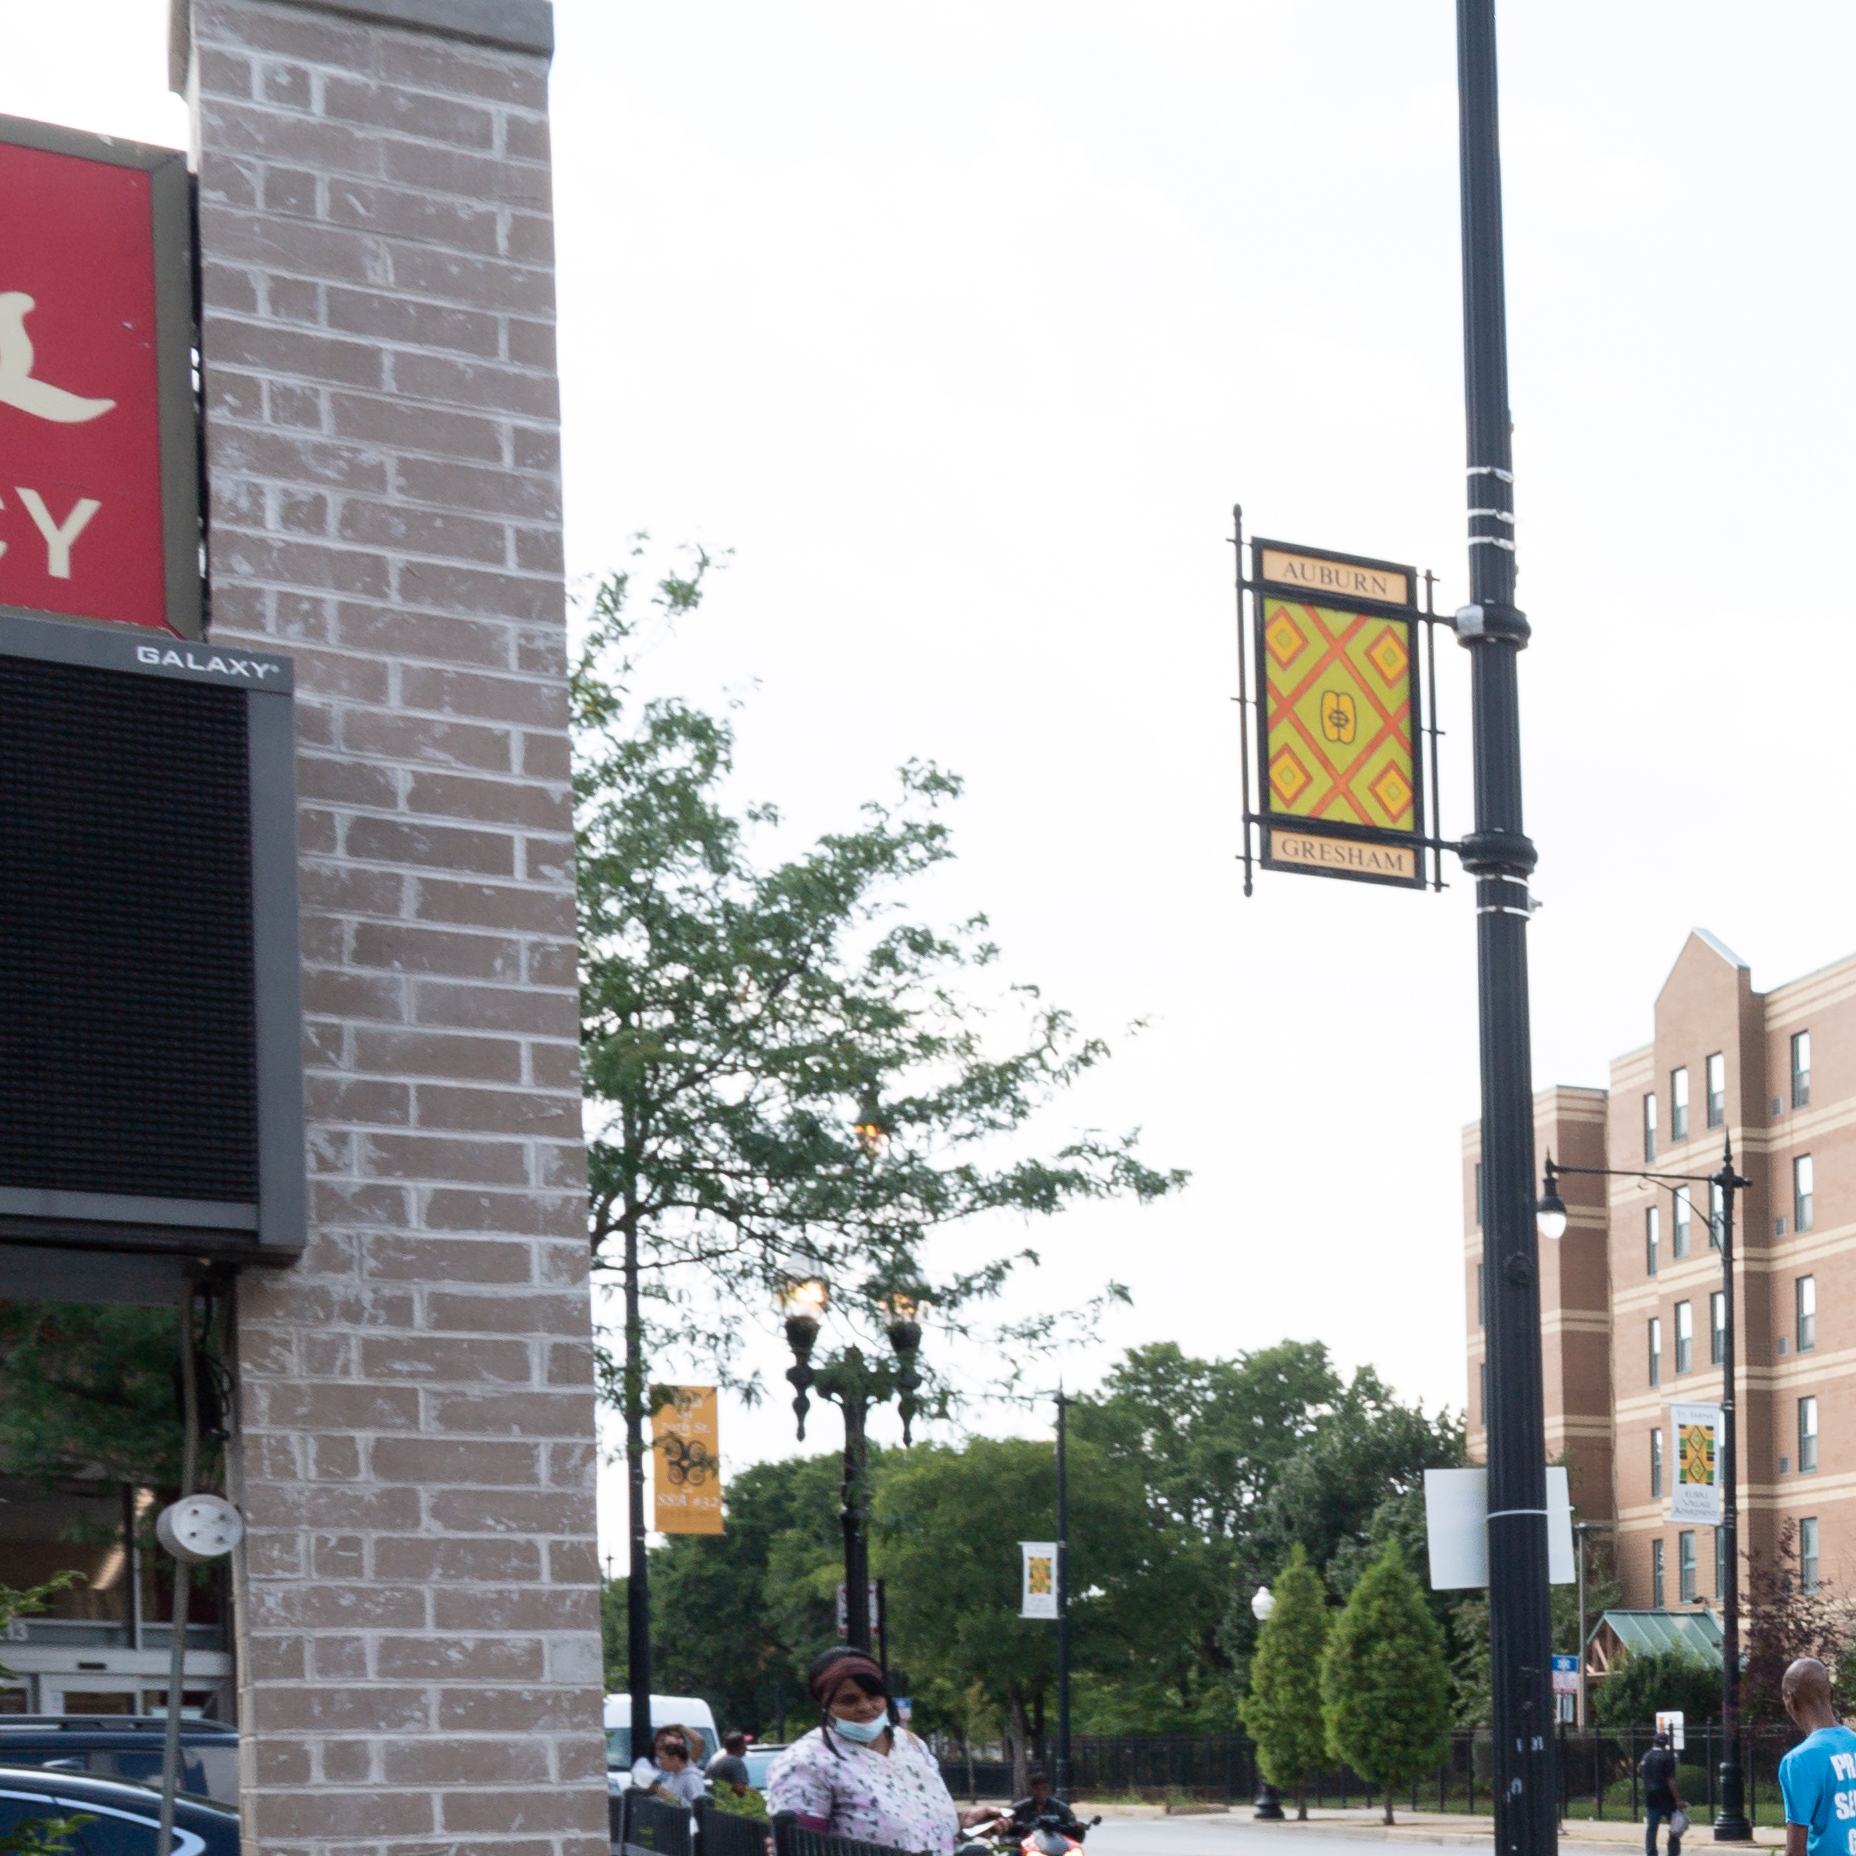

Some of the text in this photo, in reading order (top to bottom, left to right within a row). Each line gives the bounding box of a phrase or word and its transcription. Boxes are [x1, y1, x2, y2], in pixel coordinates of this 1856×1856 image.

[0, 486, 102, 580] Y
[1282, 561, 1388, 597] AUBURN
[136, 645, 265, 680] GALAXY
[1281, 837, 1404, 873] GRESHAM
